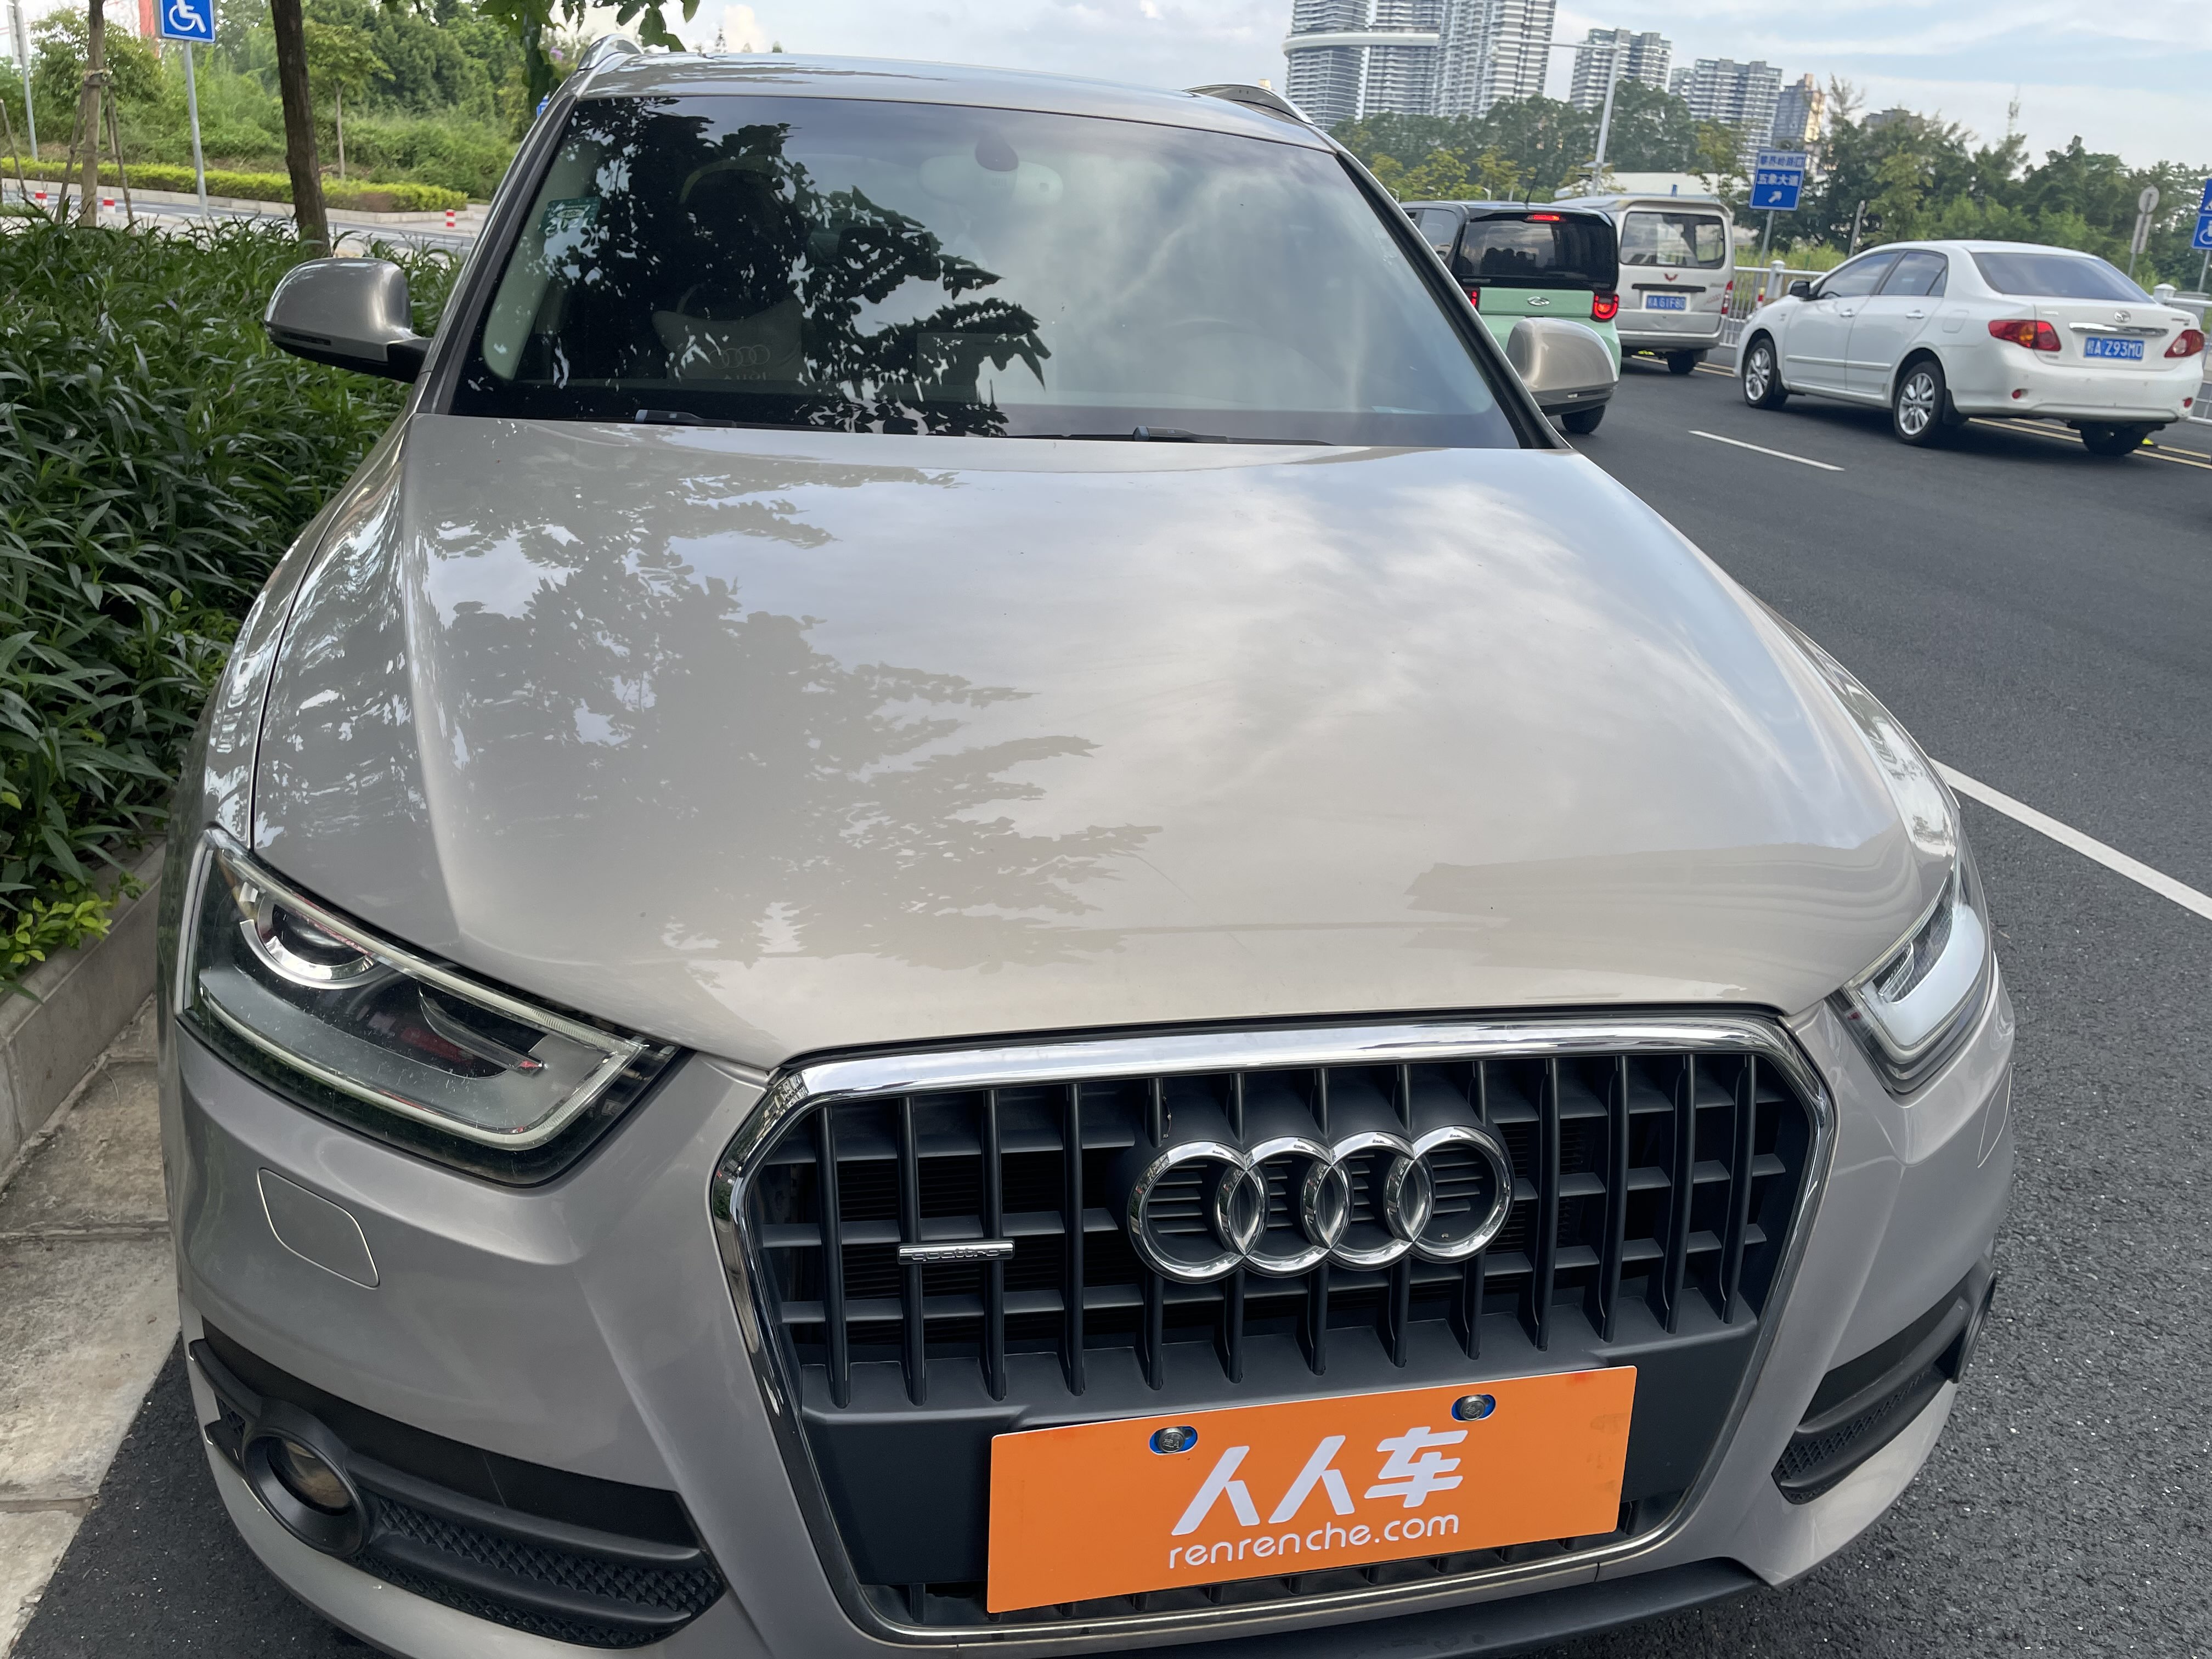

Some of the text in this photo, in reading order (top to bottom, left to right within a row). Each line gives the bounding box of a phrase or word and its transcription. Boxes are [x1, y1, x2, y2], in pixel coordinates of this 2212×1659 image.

[1757, 173, 1800, 187] 五象大道
[911, 1248, 1000, 1262] quattro
[1171, 1426, 1469, 1536] 人人车
[1169, 1513, 1459, 1569] renrenche.com
